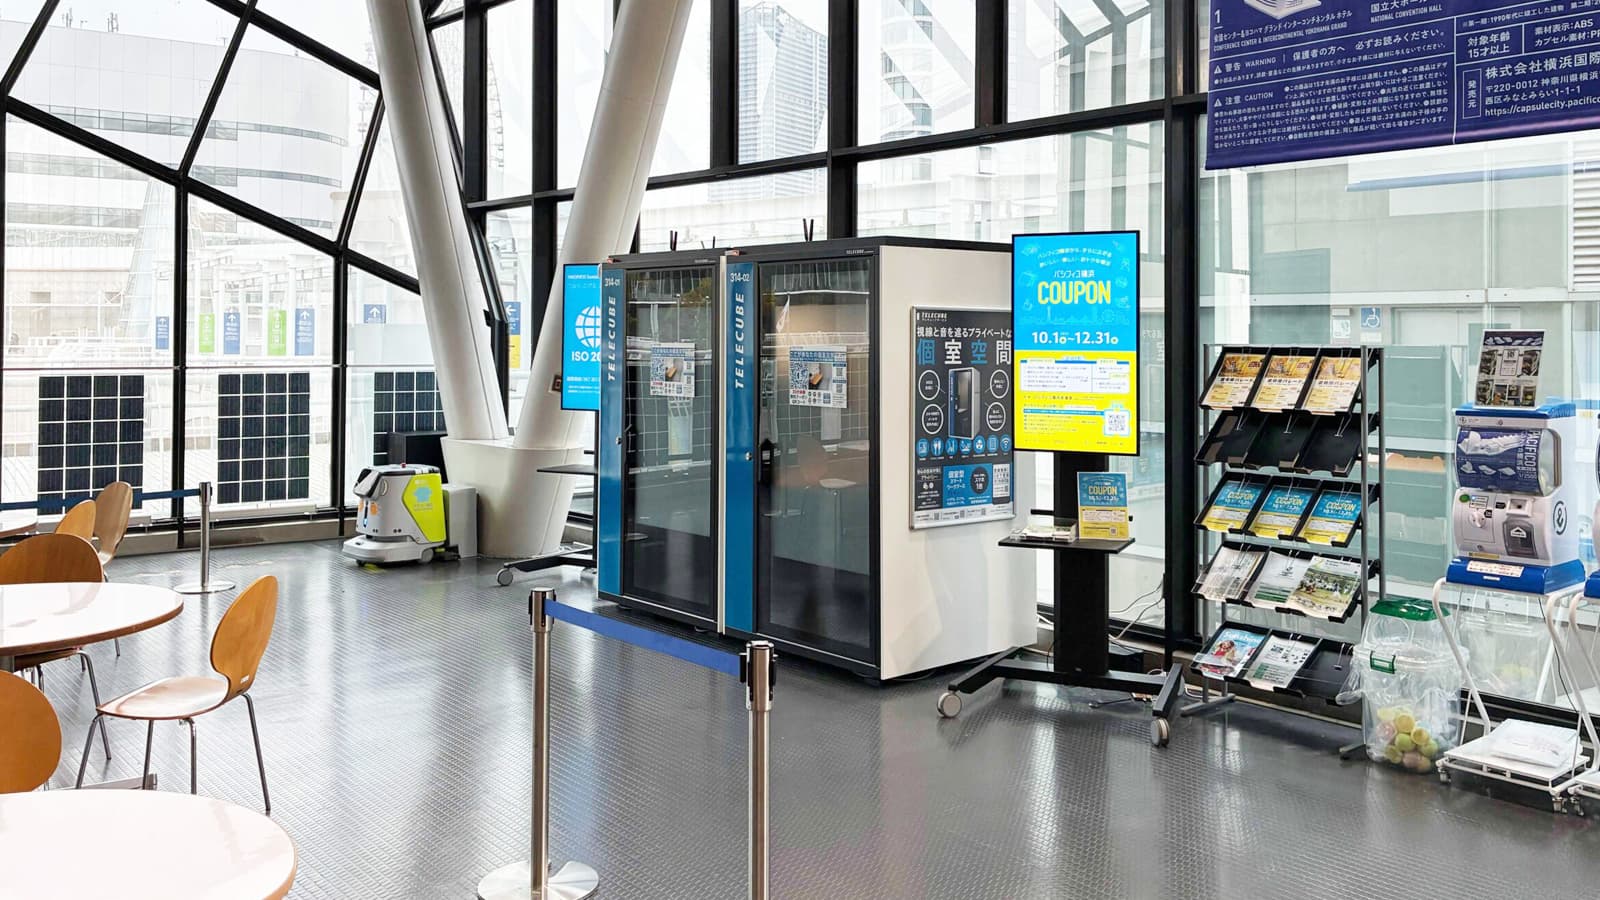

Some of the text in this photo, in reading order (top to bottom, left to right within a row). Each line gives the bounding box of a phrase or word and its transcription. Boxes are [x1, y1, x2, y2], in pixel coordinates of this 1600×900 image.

[1371, 0, 1426, 13] 国立大ホー
[1371, 4, 1443, 23] NATIONAL CONVENTION HALL
[1214, 9, 1221, 24] 1
[1214, 39, 1240, 52] CONFERENCE
[1241, 37, 1257, 47] CENTER
[1467, 31, 1510, 47] 対象年齢
[1225, 28, 1444, 72] 警告 WARNING 保護者の方へ 必ずお読みください。
[1468, 43, 1510, 58] 15才以上
[1245, 91, 1274, 101] CAUTION
[1468, 80, 1476, 108] 発売元
[1485, 85, 1581, 105] 西区みなとみらい1-1-1
[730, 272, 750, 283] 314-02
[1037, 279, 1111, 305] COUPON
[607, 296, 616, 381] TELECUBE
[735, 293, 744, 389] TELECUBE
[571, 351, 589, 362] ISO
[1088, 486, 1118, 495] COUPON
